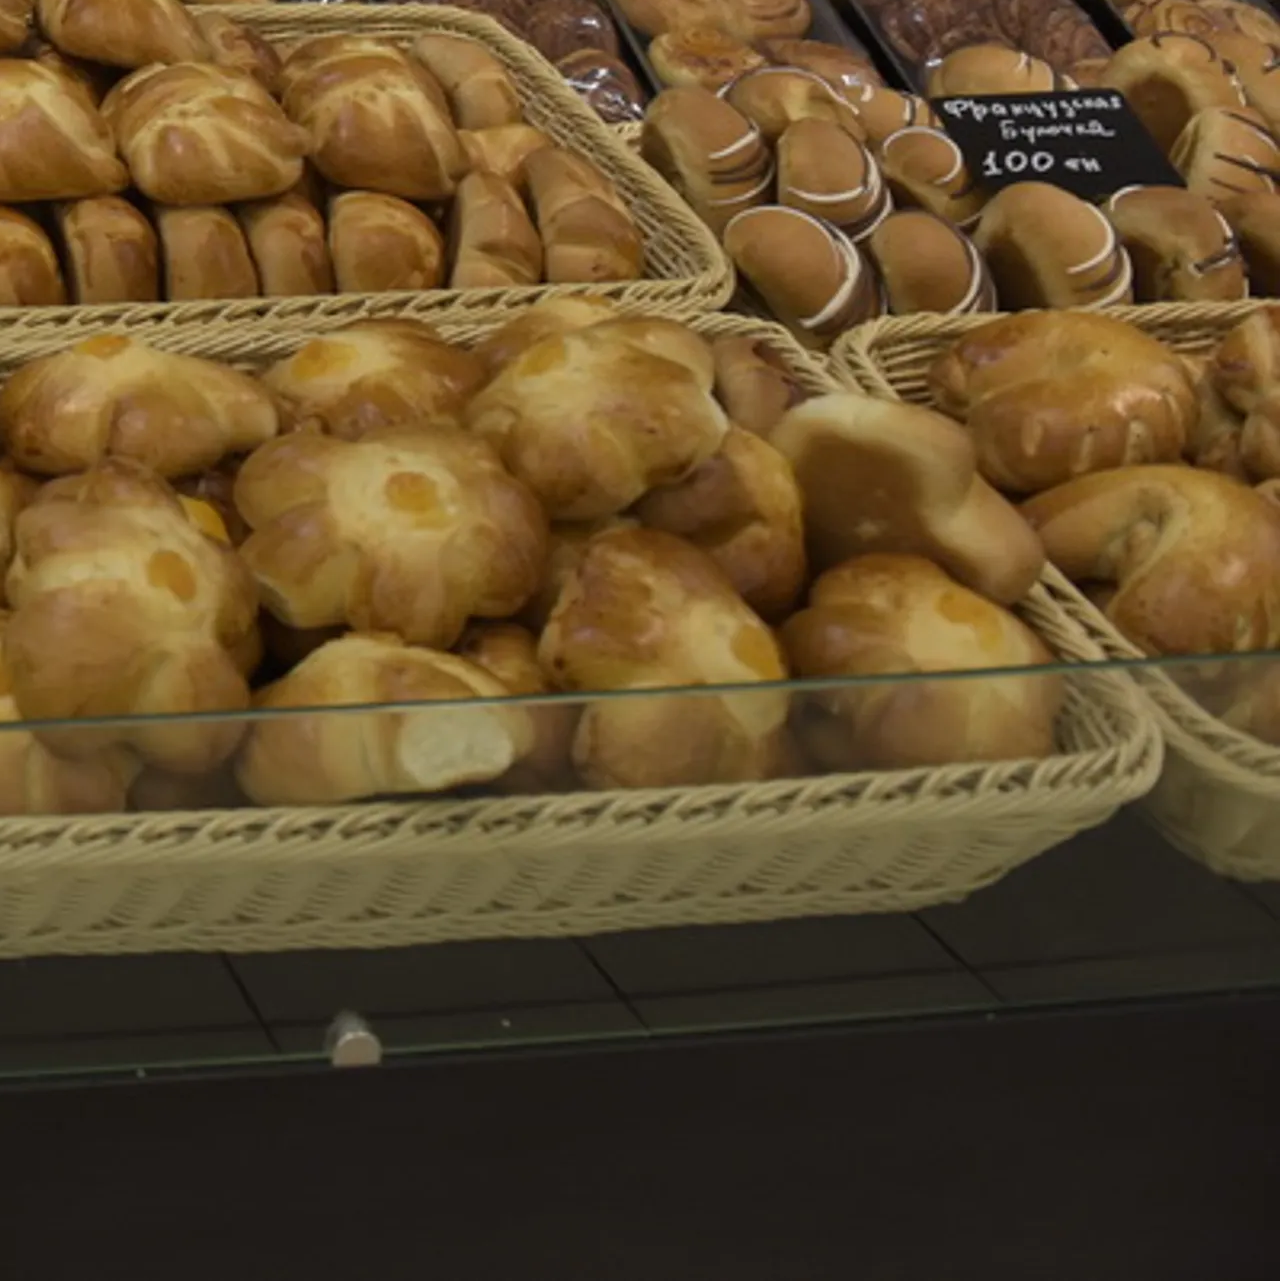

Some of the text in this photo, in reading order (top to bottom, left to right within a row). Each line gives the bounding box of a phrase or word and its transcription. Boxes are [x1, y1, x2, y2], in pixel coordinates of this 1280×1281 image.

[942, 95, 1123, 122] Французская
[998, 119, 1117, 145] Булочка
[982, 150, 1056, 177] 100
